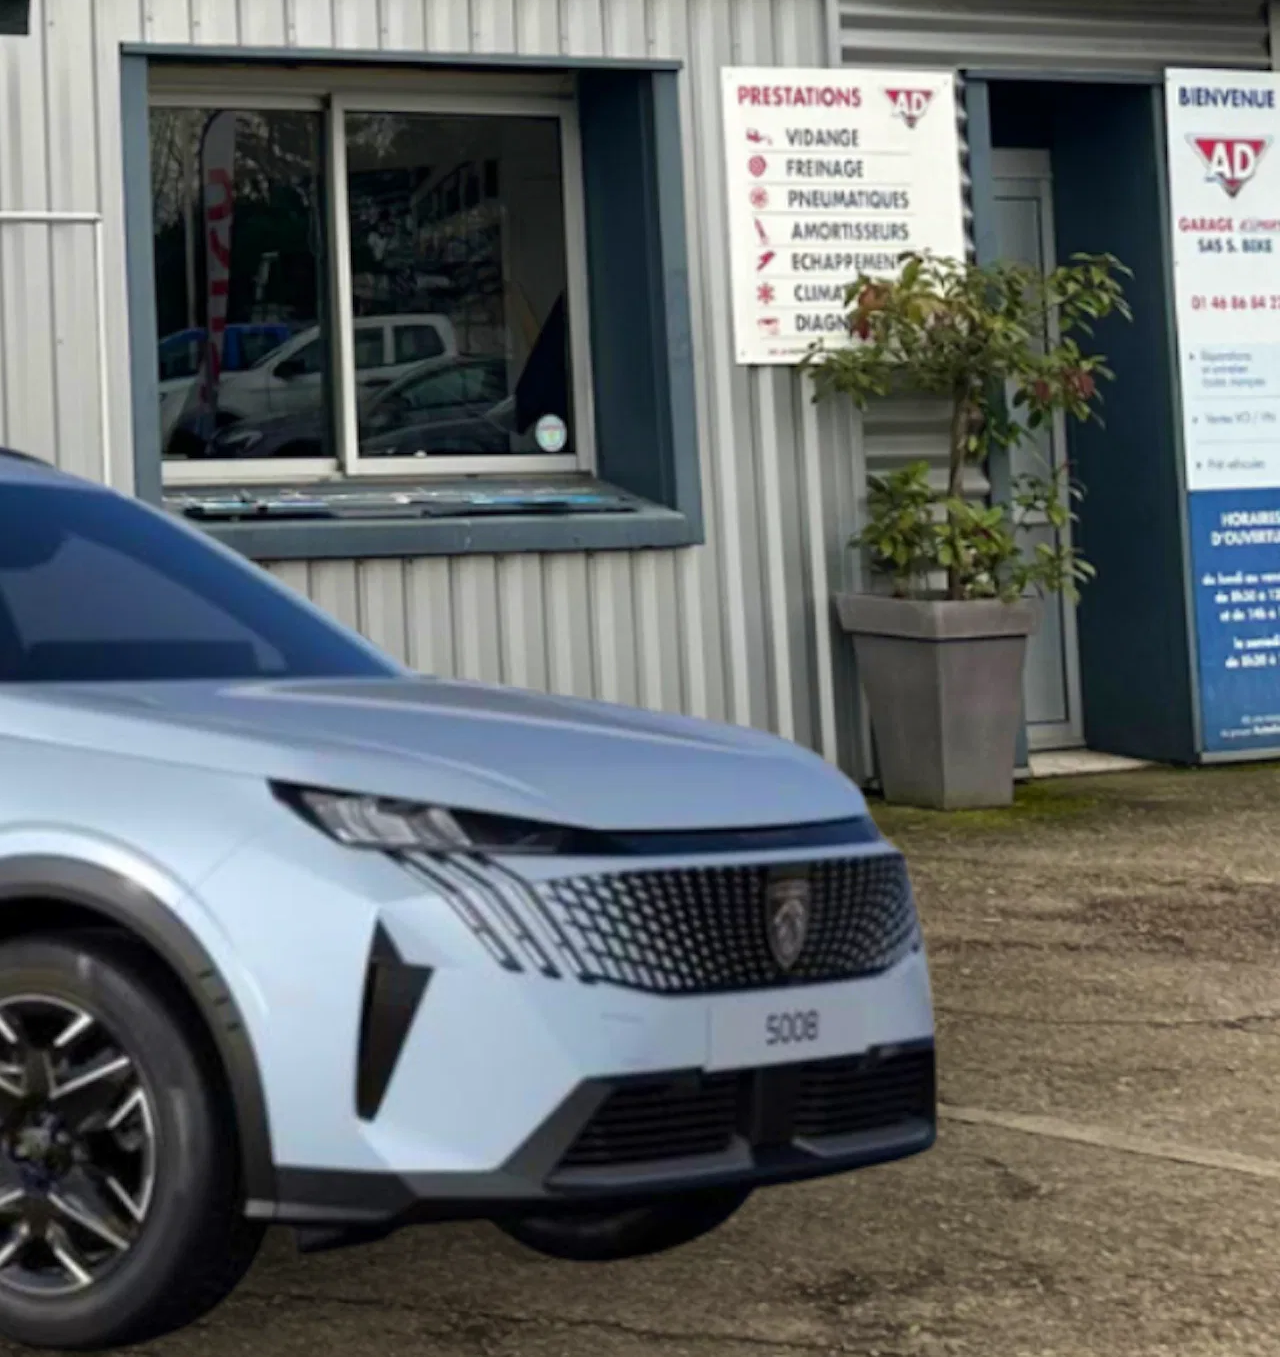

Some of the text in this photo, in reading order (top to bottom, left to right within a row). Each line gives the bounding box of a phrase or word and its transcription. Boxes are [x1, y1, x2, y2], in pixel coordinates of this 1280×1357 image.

[737, 85, 862, 108] PRESTATIONS
[1178, 87, 1275, 108] BIENVENUE
[785, 128, 859, 146] VIDANGE
[786, 159, 864, 178] FREINAGE
[1209, 142, 1256, 180] AD
[788, 189, 910, 209] PNEUMATIQUES
[791, 222, 910, 241] AMORTISSEURS
[791, 252, 900, 270] ECHAPPEMEN
[766, 1009, 819, 1046] 5008
